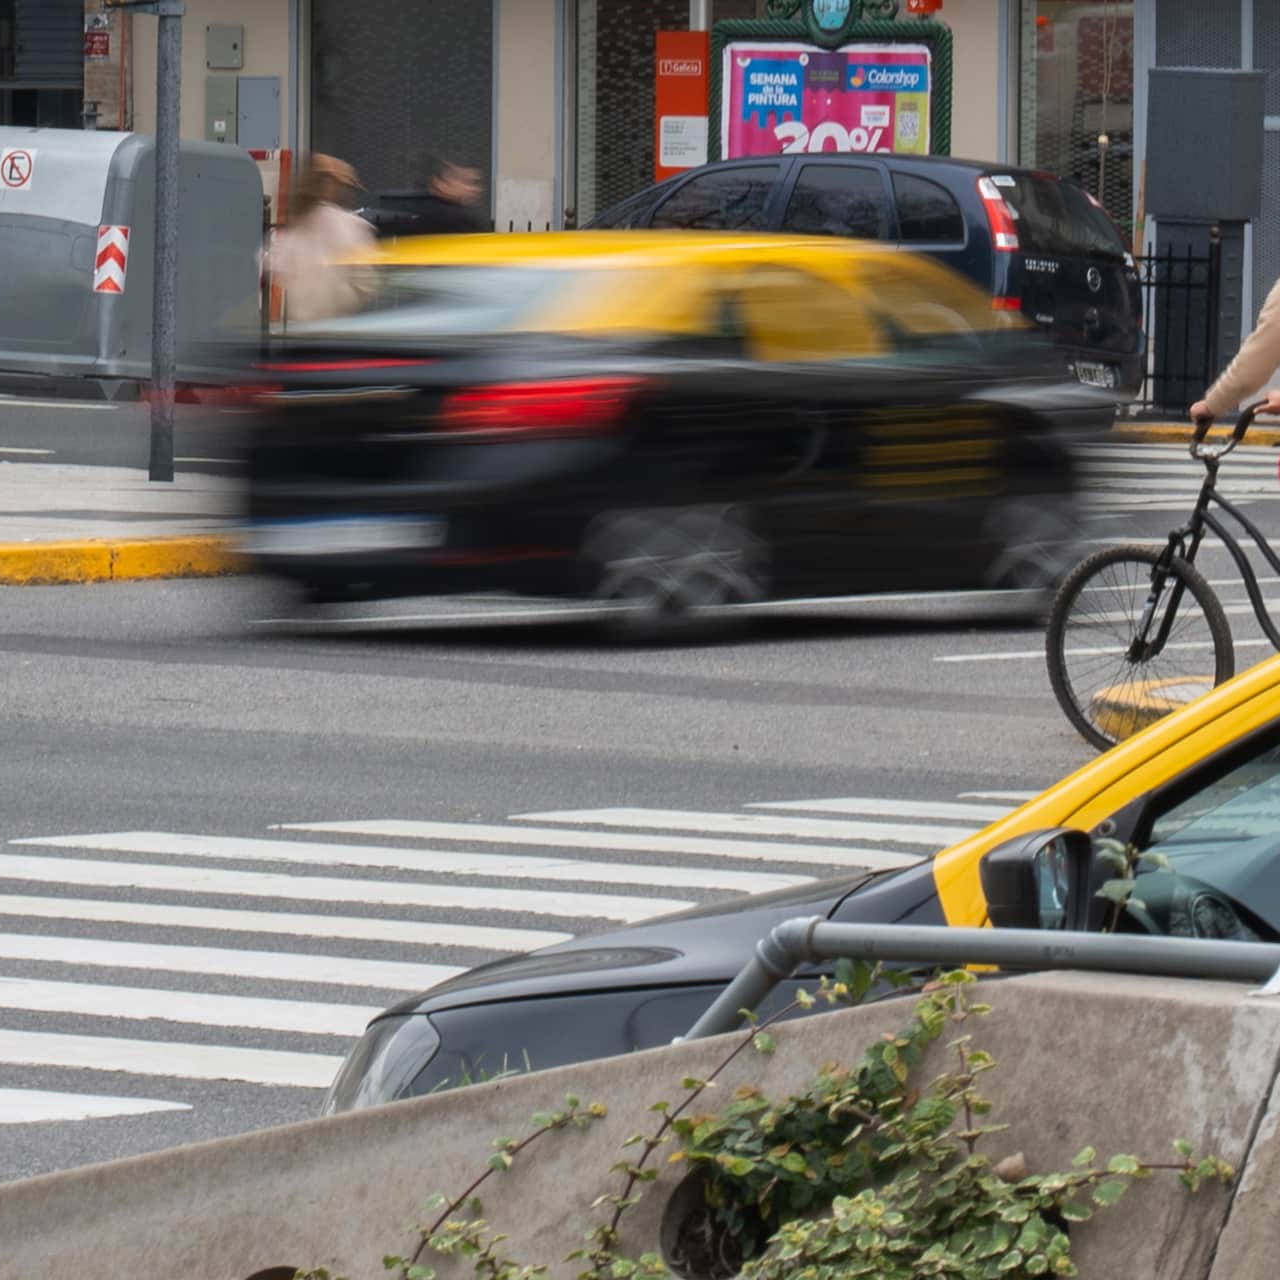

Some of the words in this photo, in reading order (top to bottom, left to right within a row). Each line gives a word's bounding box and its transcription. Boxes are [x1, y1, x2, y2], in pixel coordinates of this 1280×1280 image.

[749, 72, 798, 86] SEMANA
[868, 67, 920, 89] Colorshop
[748, 92, 798, 106] PINTURA
